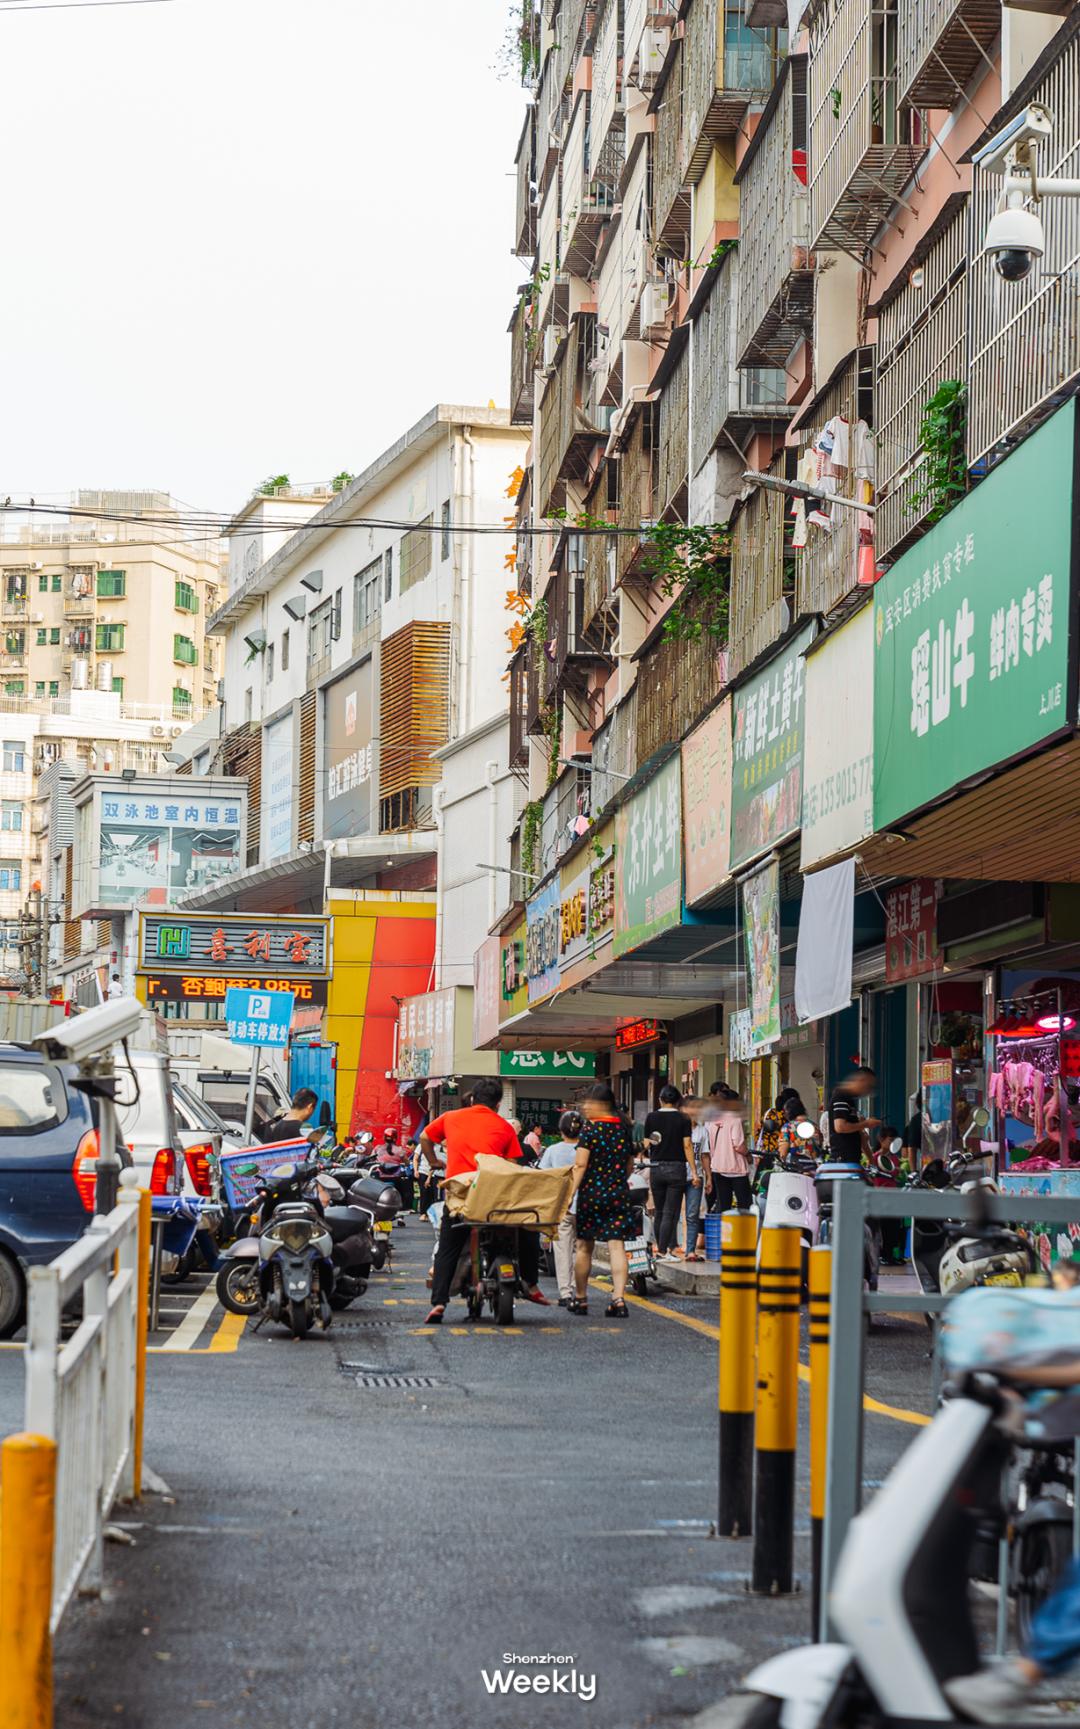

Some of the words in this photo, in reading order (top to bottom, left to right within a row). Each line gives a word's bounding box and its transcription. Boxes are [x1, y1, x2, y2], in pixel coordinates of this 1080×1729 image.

[911, 598, 975, 737] 瑶山牛
[989, 574, 1053, 681] 鲜肉专卖
[745, 656, 805, 762] 新鲜土黄牛
[1039, 682, 1063, 716] 上川店
[104, 802, 239, 824] 双泳池室内恒温
[203, 927, 312, 963] 喜利宝
[252, 997, 263, 1015] P
[227, 1019, 287, 1043] 机动车停放处
